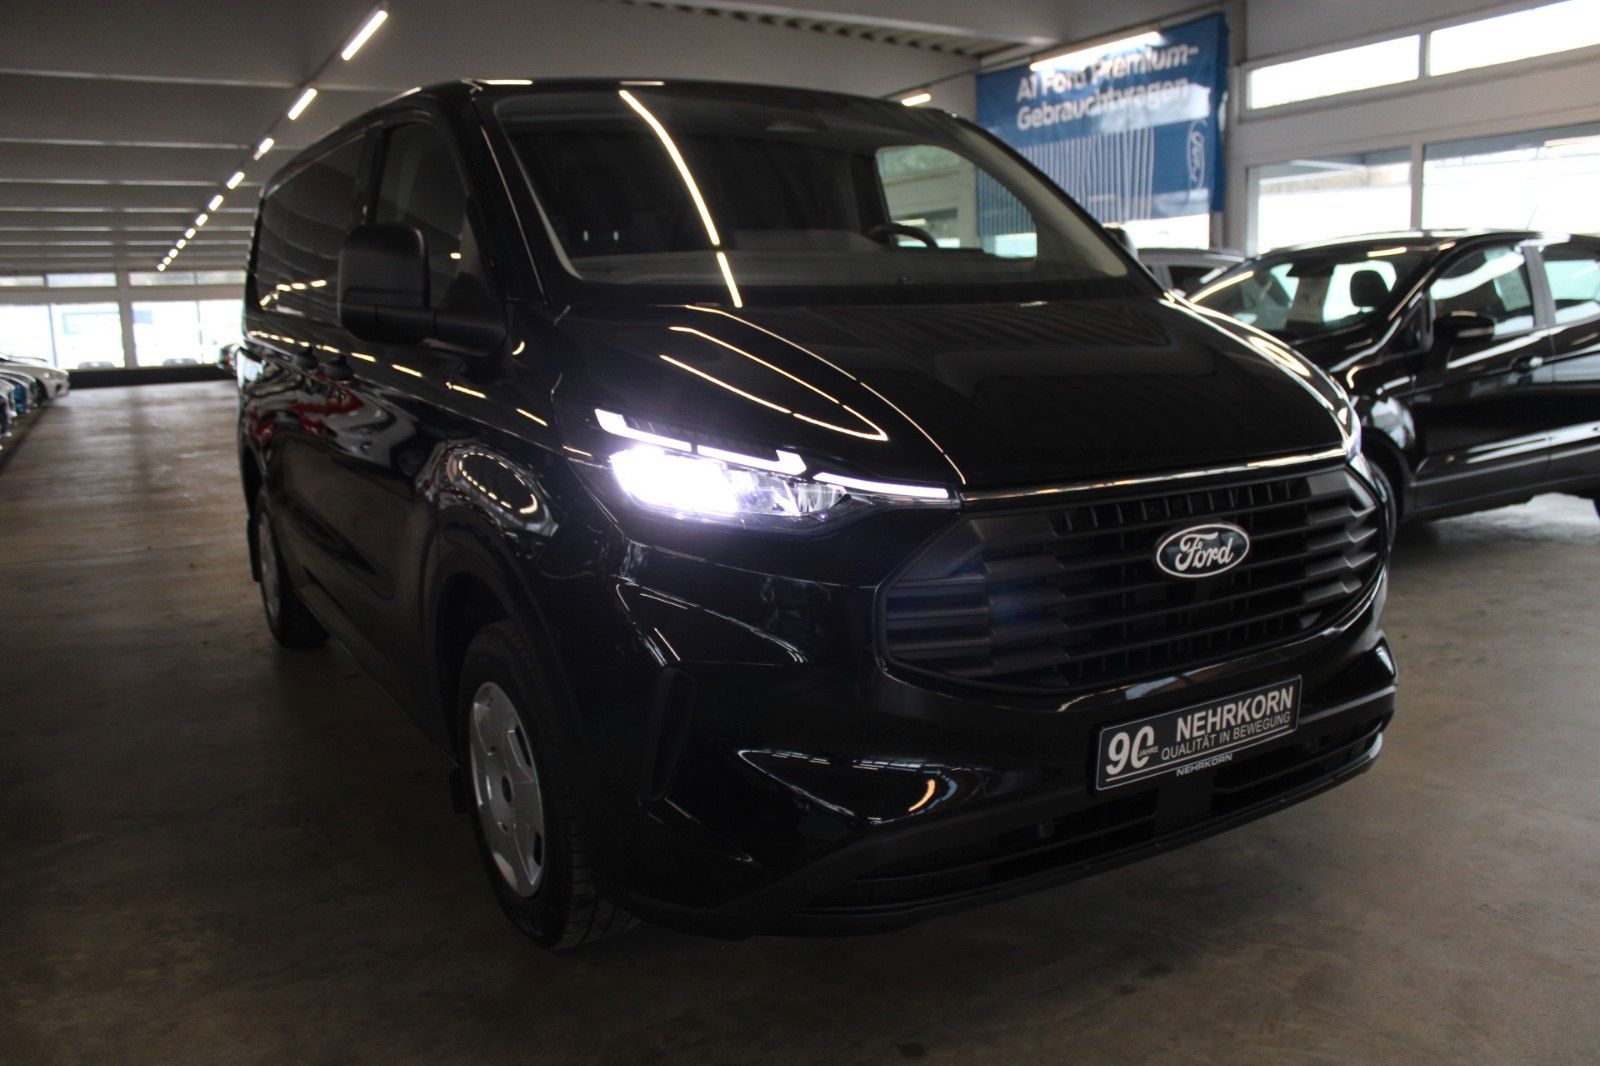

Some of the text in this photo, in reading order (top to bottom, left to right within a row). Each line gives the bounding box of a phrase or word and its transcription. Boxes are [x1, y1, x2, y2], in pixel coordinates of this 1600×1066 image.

[1175, 531, 1234, 571] Ford
[1161, 711, 1291, 761] QUALITÄT IN BEWEGUNG
[1176, 685, 1295, 742] NEHRKORN
[1106, 725, 1155, 776] 90
[1176, 752, 1233, 777] NEHRKORN
